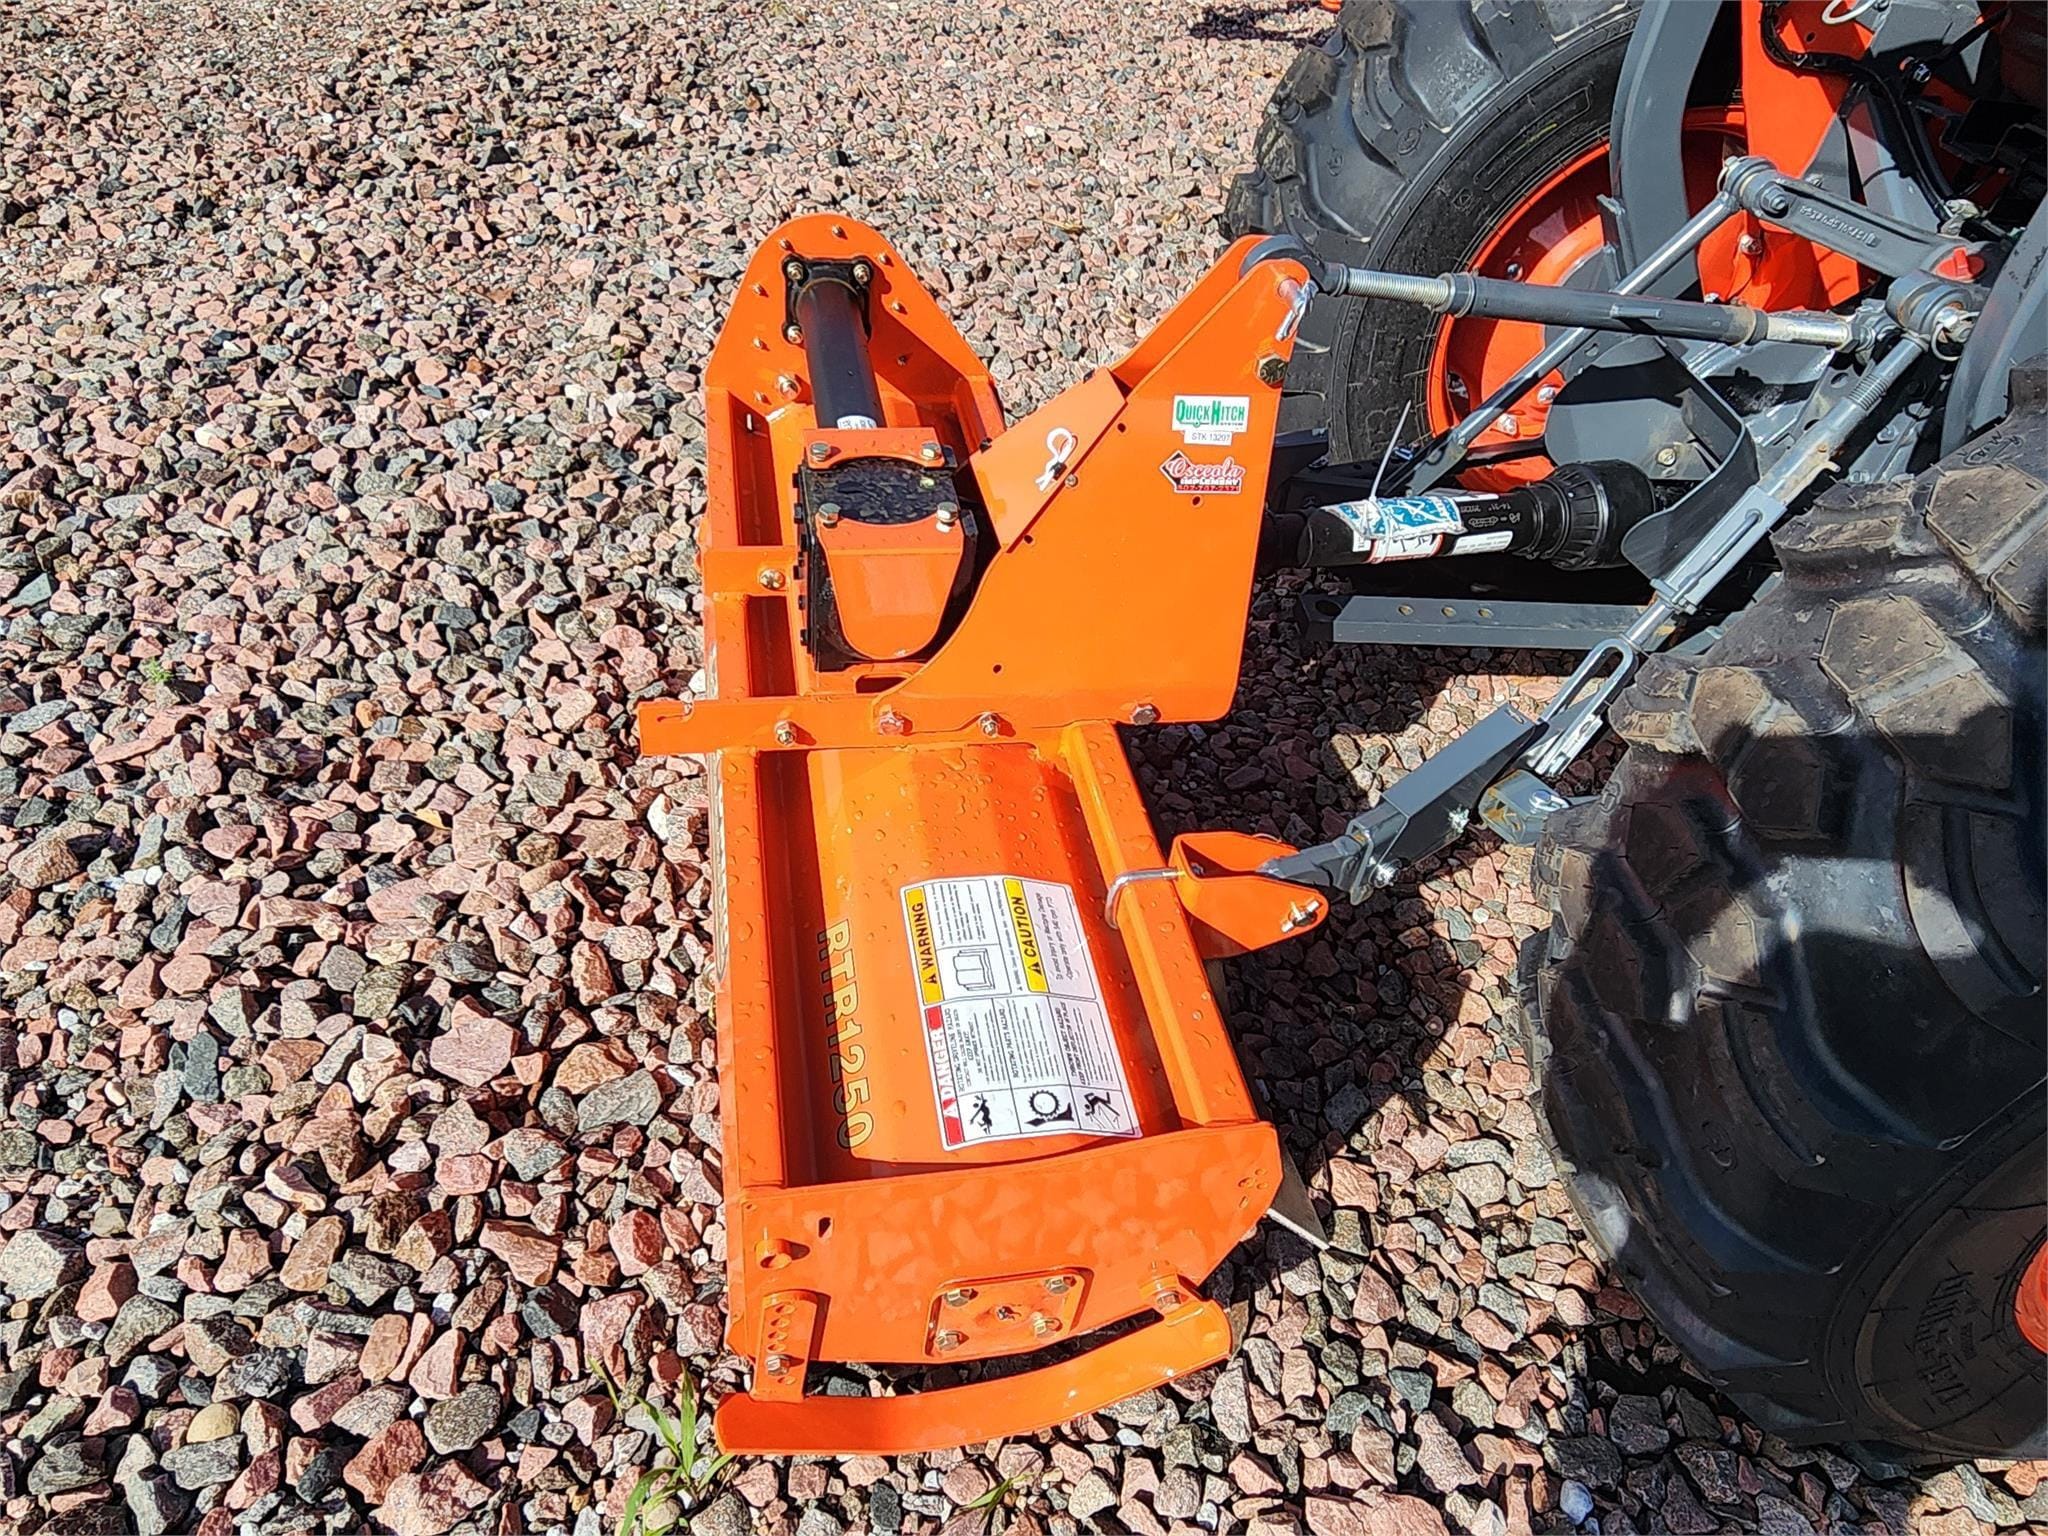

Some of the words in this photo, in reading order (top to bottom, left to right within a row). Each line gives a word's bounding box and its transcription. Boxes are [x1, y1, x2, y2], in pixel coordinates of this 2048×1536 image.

[1164, 457, 1244, 478] Osceola
[912, 902, 935, 970] WARNING
[1013, 896, 1038, 958] CAUTION
[817, 918, 875, 1150] RTR1250
[932, 1028, 953, 1097] DANGER
